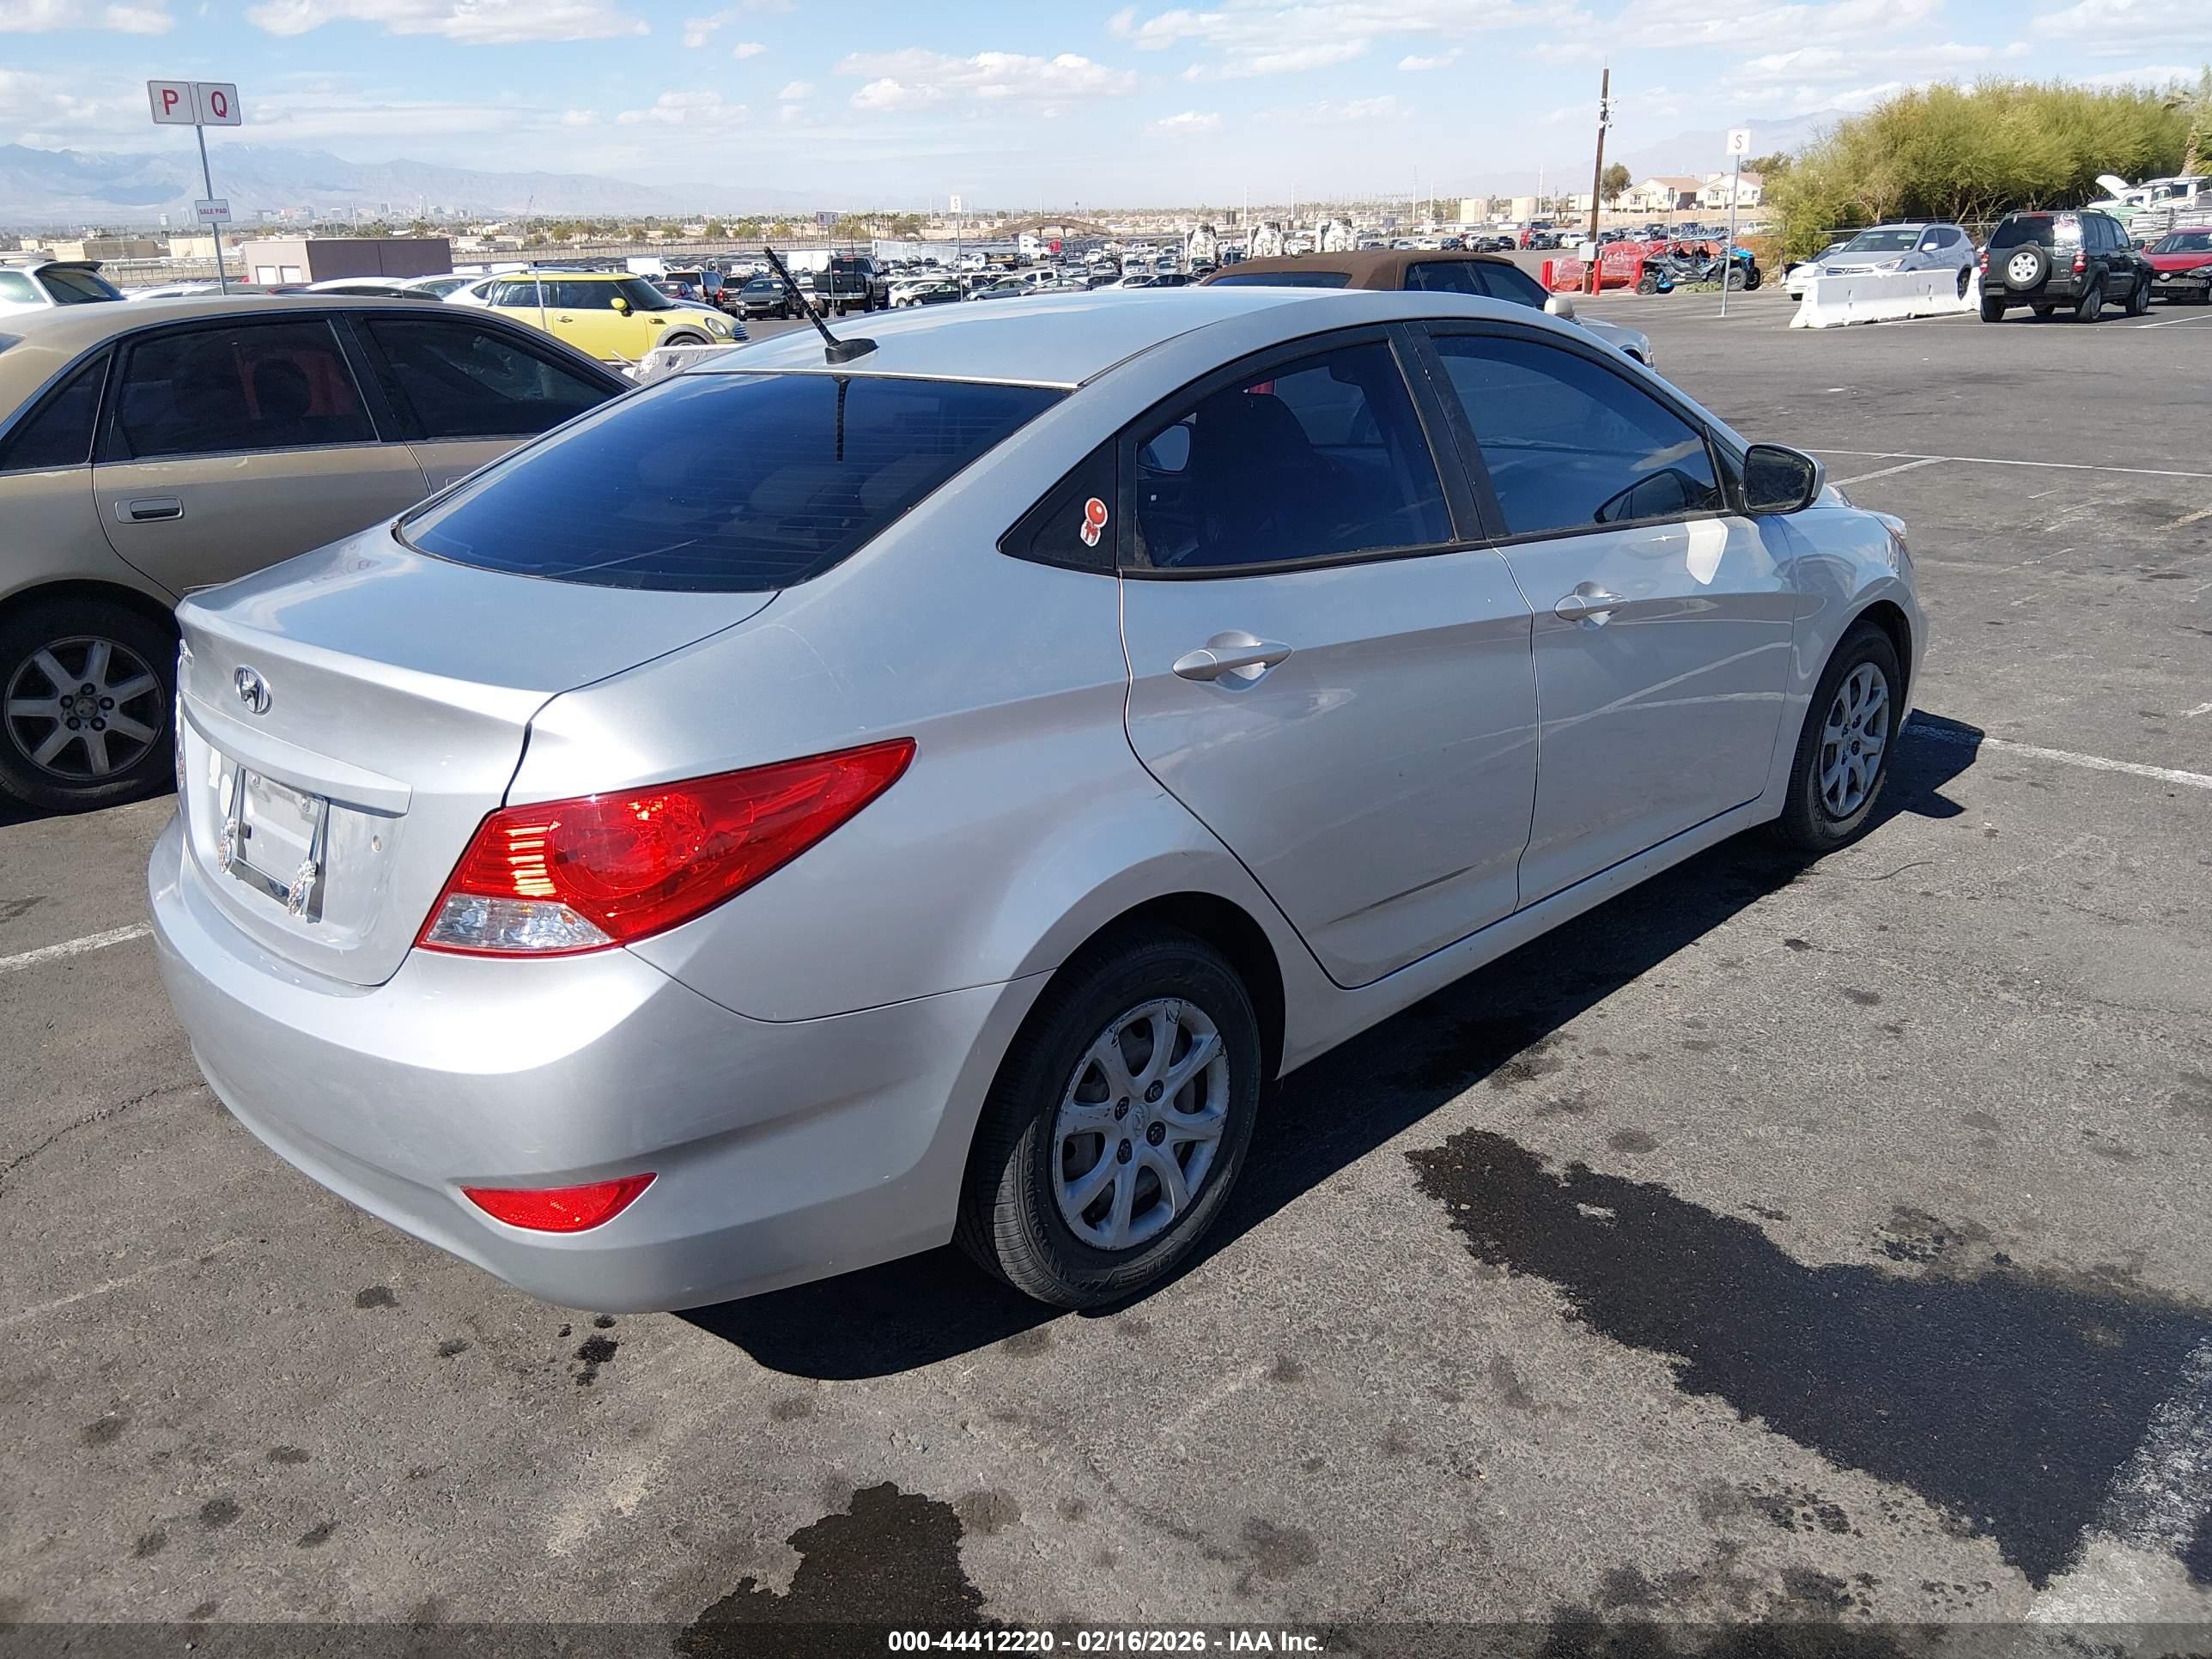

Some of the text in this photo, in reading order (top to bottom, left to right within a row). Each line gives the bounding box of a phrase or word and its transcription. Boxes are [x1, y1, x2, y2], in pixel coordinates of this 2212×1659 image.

[162, 88, 228, 118] P Q
[1735, 134, 1743, 149] S
[819, 214, 825, 223] R
